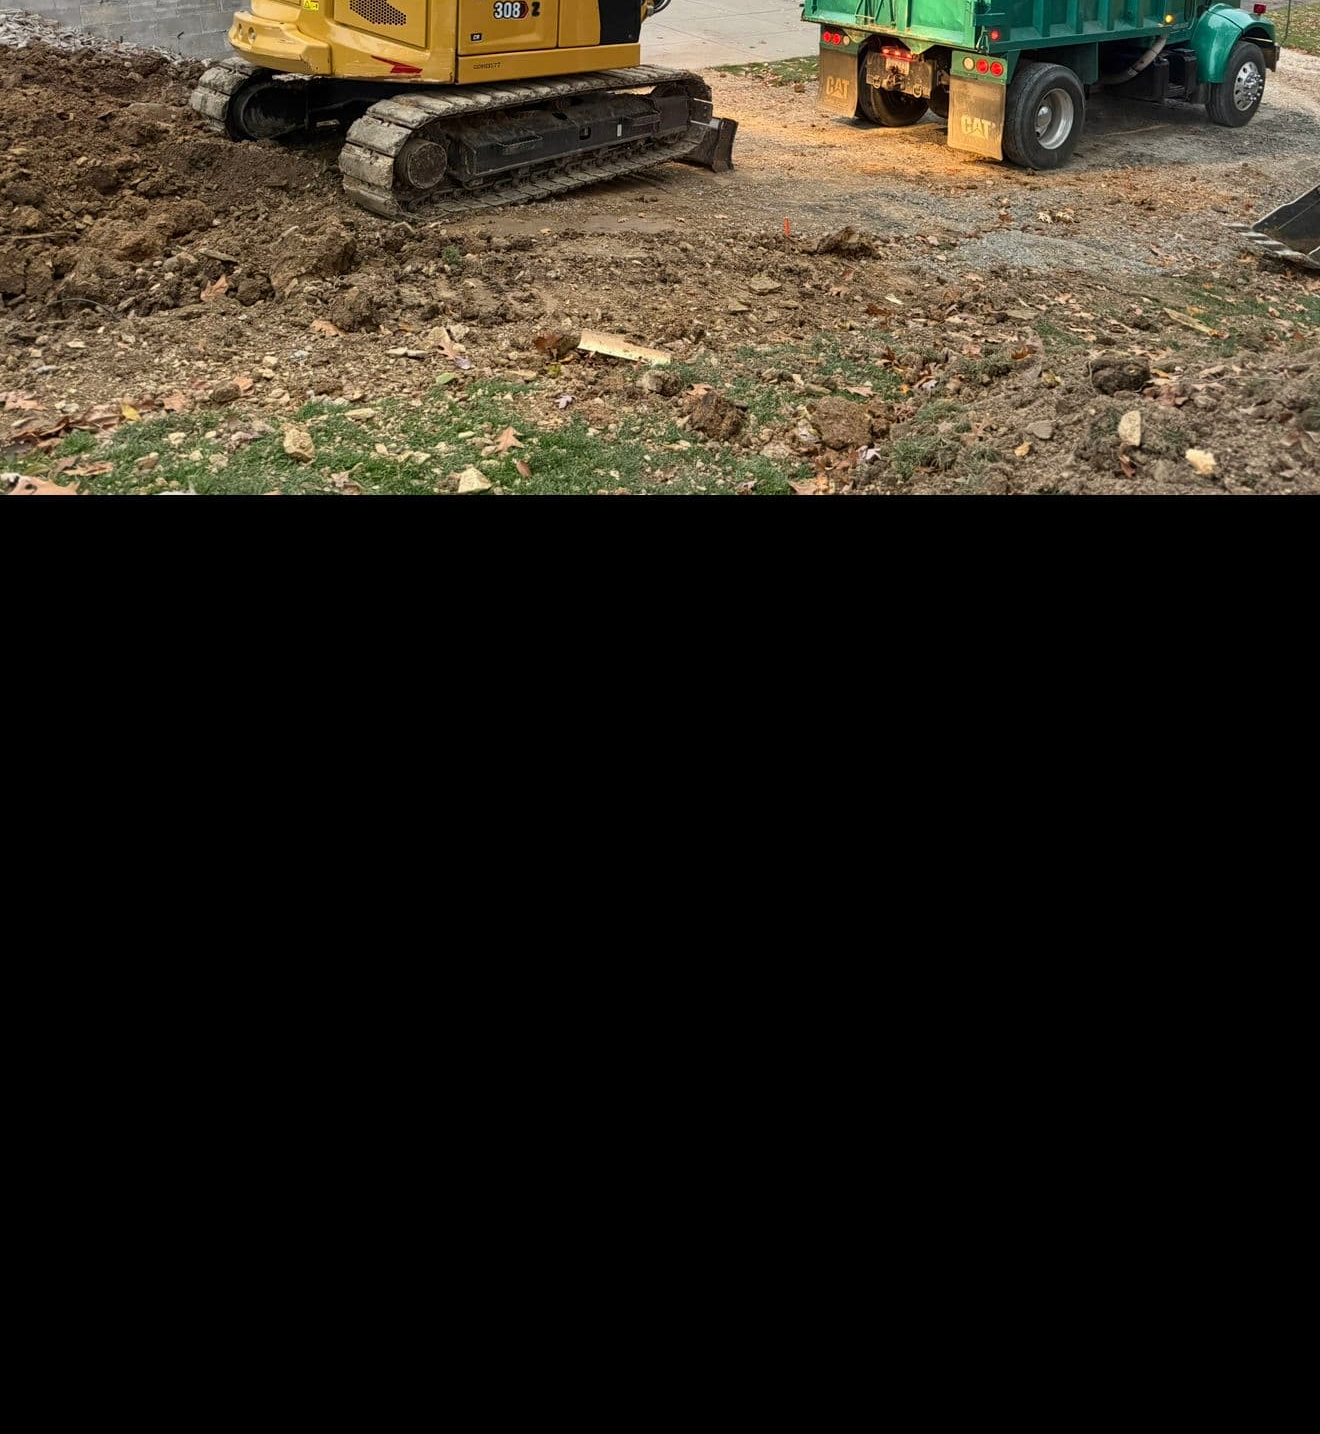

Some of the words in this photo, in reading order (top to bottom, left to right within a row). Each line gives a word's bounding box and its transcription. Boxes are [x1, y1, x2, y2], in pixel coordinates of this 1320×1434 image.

[494, 1, 521, 19] 308
[826, 76, 850, 99] CAT
[960, 115, 991, 140] CAT
